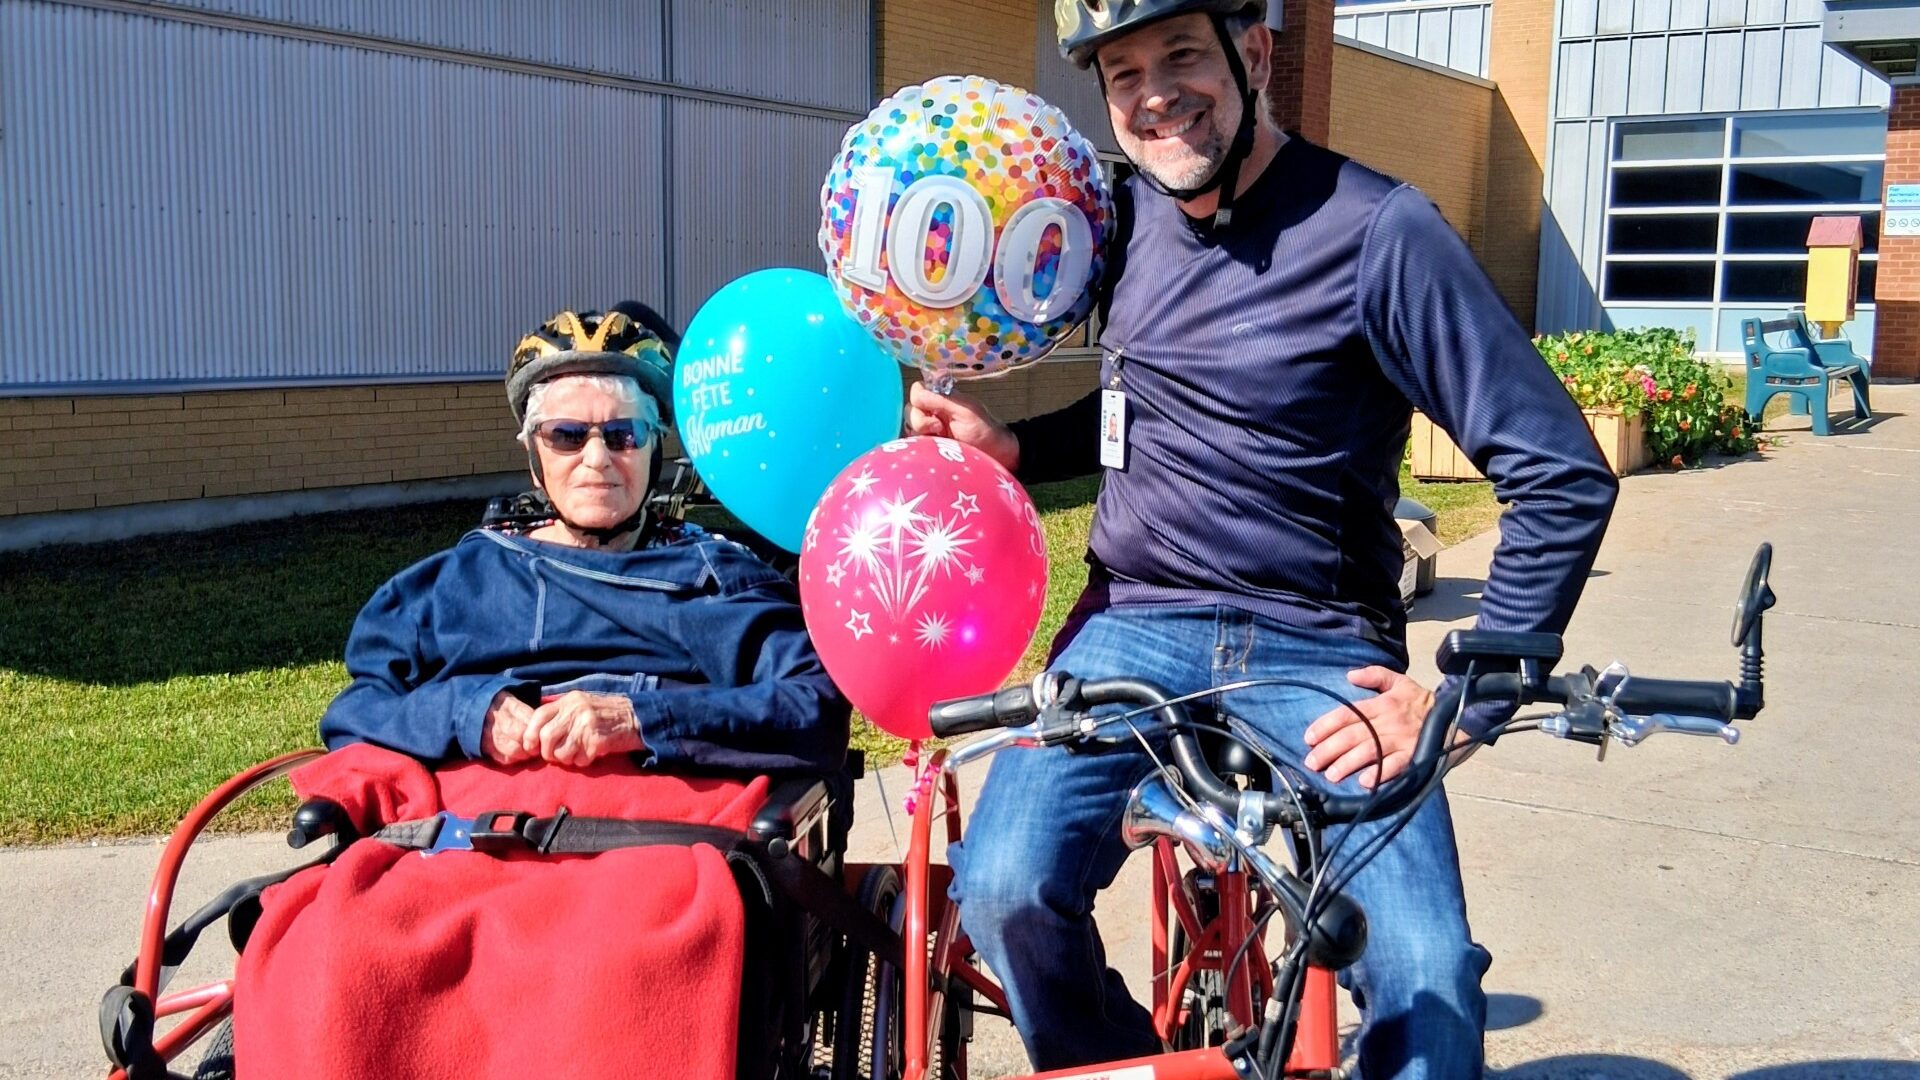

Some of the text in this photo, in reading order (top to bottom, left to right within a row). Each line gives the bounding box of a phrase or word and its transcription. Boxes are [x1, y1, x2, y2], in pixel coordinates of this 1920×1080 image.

[841, 166, 1094, 324] 100
[683, 352, 744, 388] BONNE
[691, 381, 733, 413] FÊTE
[686, 411, 768, 460] Maman
